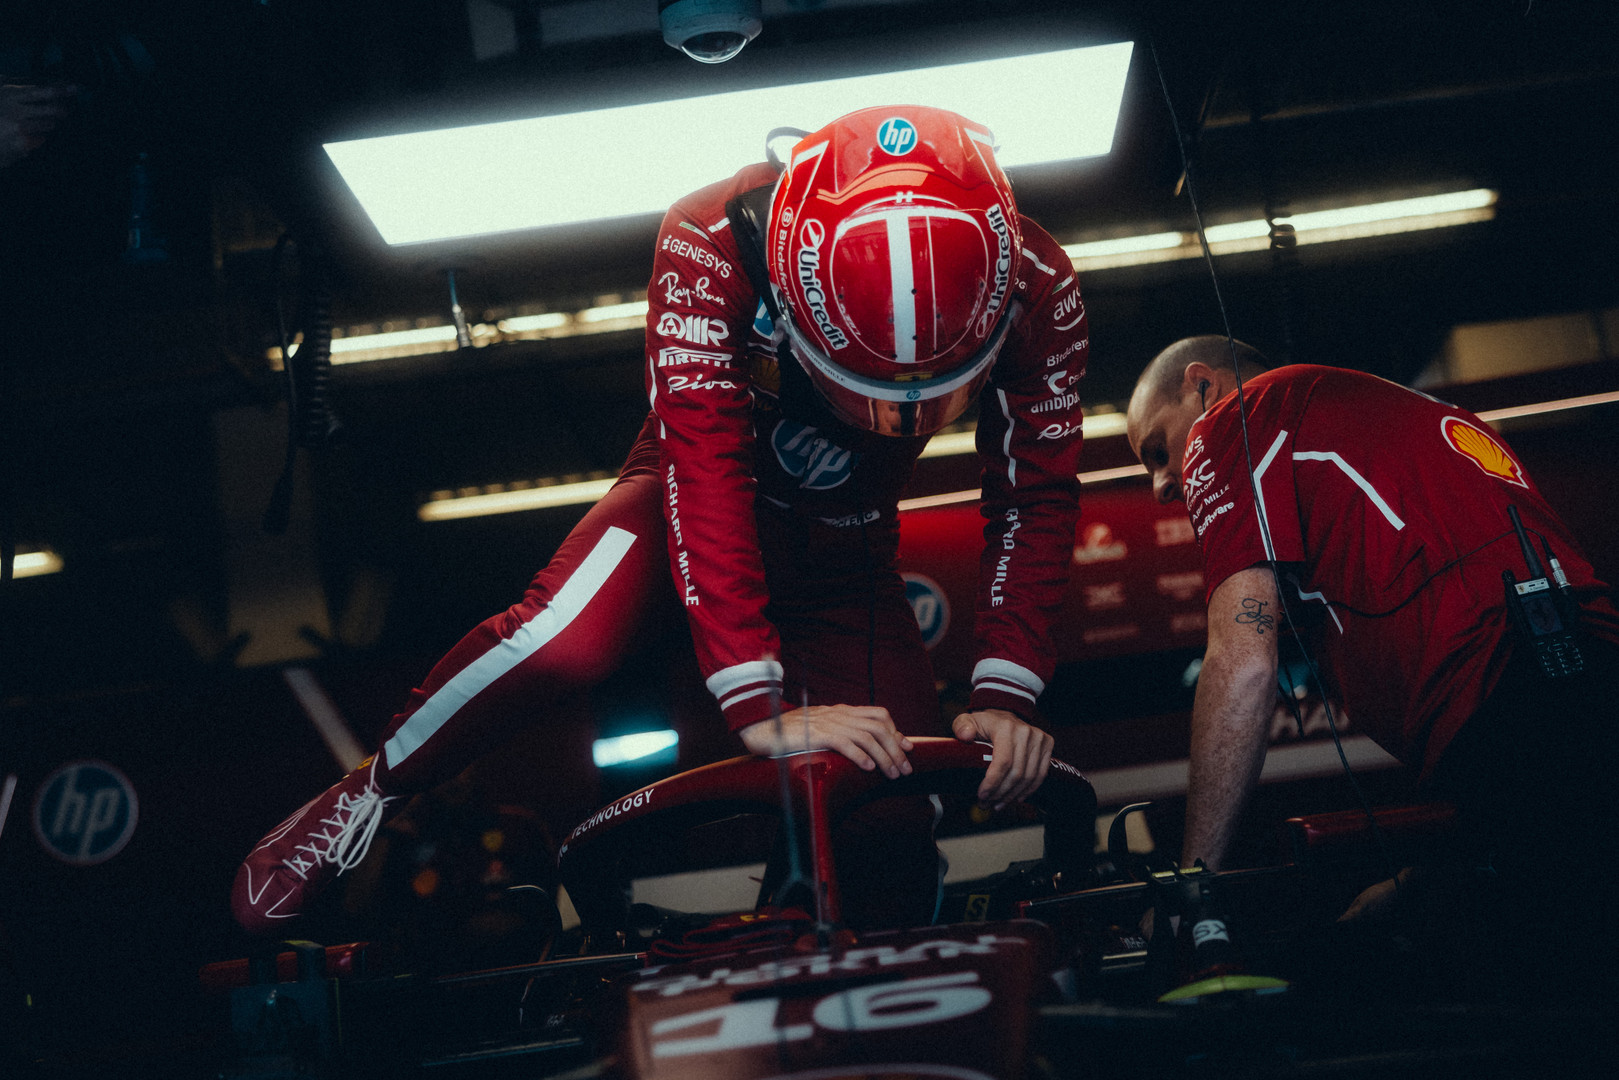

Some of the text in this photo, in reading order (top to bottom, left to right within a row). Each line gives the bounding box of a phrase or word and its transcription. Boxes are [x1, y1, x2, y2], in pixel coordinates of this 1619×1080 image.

[881, 118, 914, 155] hp
[669, 239, 732, 279] GENESYS
[988, 204, 1010, 311] UniCredit
[658, 272, 726, 307] Ray-Ban
[799, 250, 848, 350] UniCredit
[1197, 501, 1235, 536] Software
[1203, 483, 1230, 506] MILLE
[667, 463, 699, 606] RICHARD MILLE
[991, 556, 1011, 607] MILLE
[48, 765, 123, 859] hp
[571, 788, 655, 840] TECHNOLOGY
[651, 970, 993, 1059] 16
